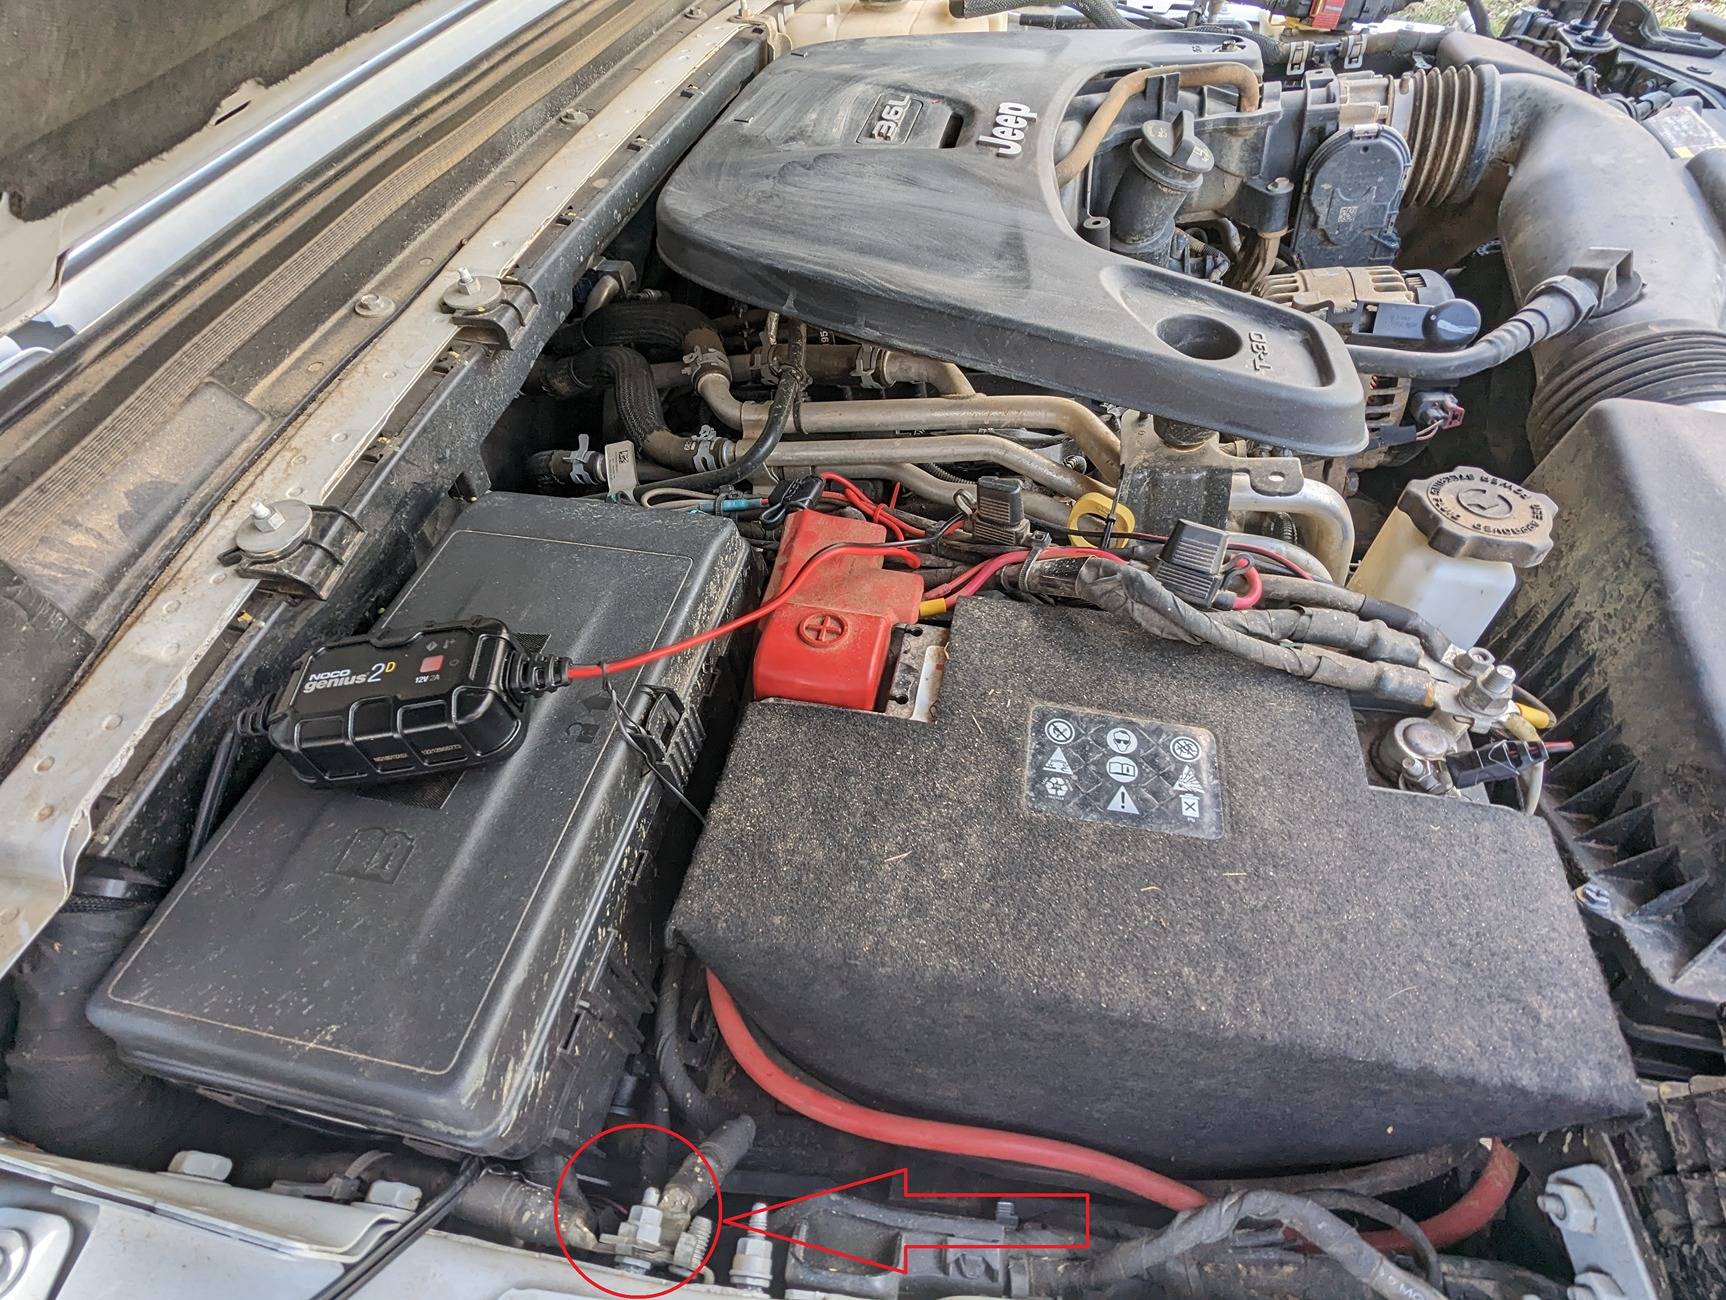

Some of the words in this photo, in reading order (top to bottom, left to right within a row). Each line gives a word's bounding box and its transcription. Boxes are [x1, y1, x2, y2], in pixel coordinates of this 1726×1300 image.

[977, 101, 1038, 157] Jeep
[309, 669, 351, 681] NOCO
[415, 675, 429, 684] 12V
